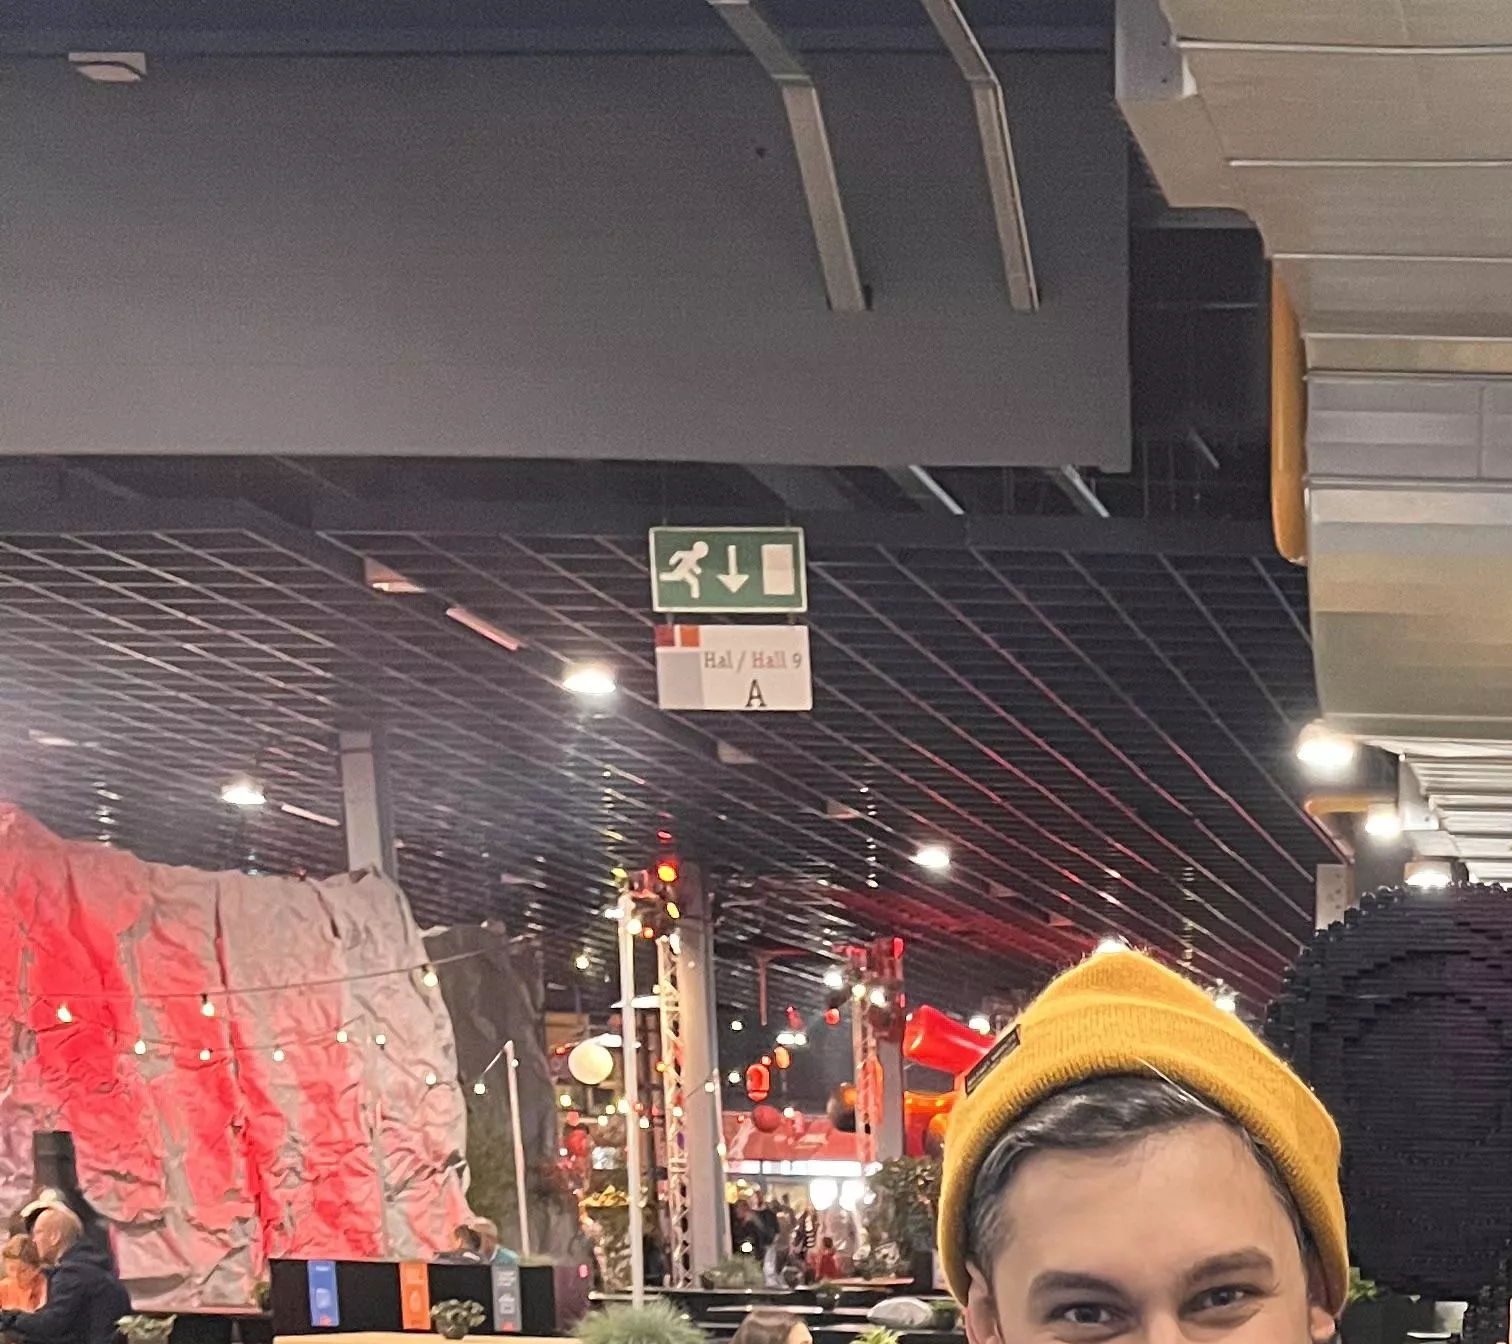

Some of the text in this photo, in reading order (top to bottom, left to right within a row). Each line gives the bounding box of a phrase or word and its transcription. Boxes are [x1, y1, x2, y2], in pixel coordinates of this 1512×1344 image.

[704, 651, 733, 669] Hal
[752, 651, 787, 669] Hall
[792, 652, 802, 669] 9
[745, 679, 768, 707] A
